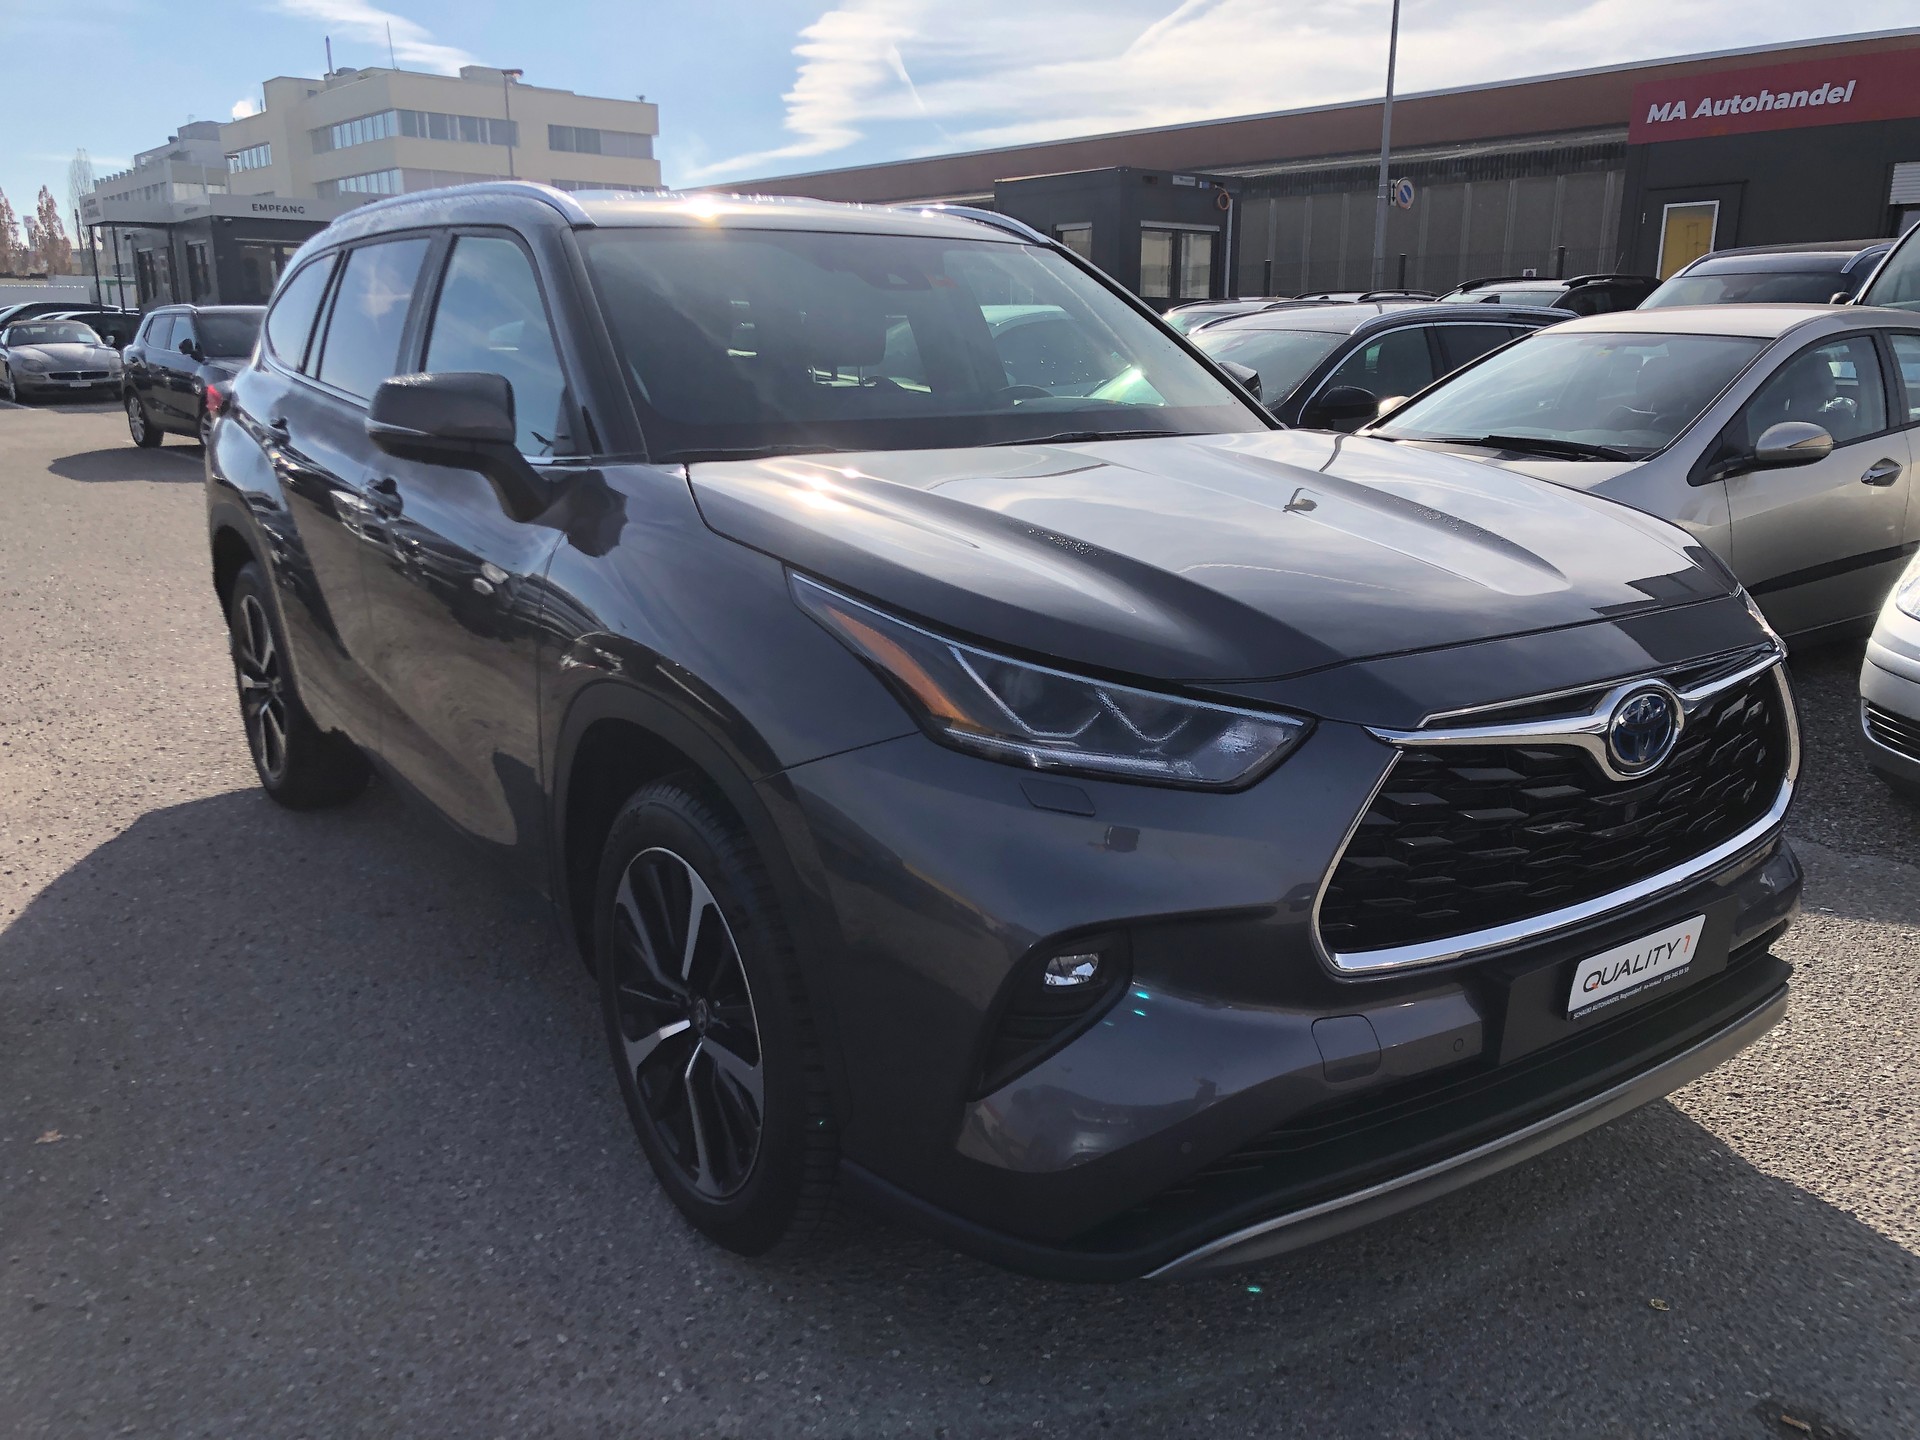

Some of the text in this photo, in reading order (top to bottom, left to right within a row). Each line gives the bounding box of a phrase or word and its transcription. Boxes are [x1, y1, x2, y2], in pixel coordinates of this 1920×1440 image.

[1646, 79, 1857, 124] MA Autohandel
[251, 203, 305, 214] EMPFANG
[1583, 937, 1681, 993] QUALITY
